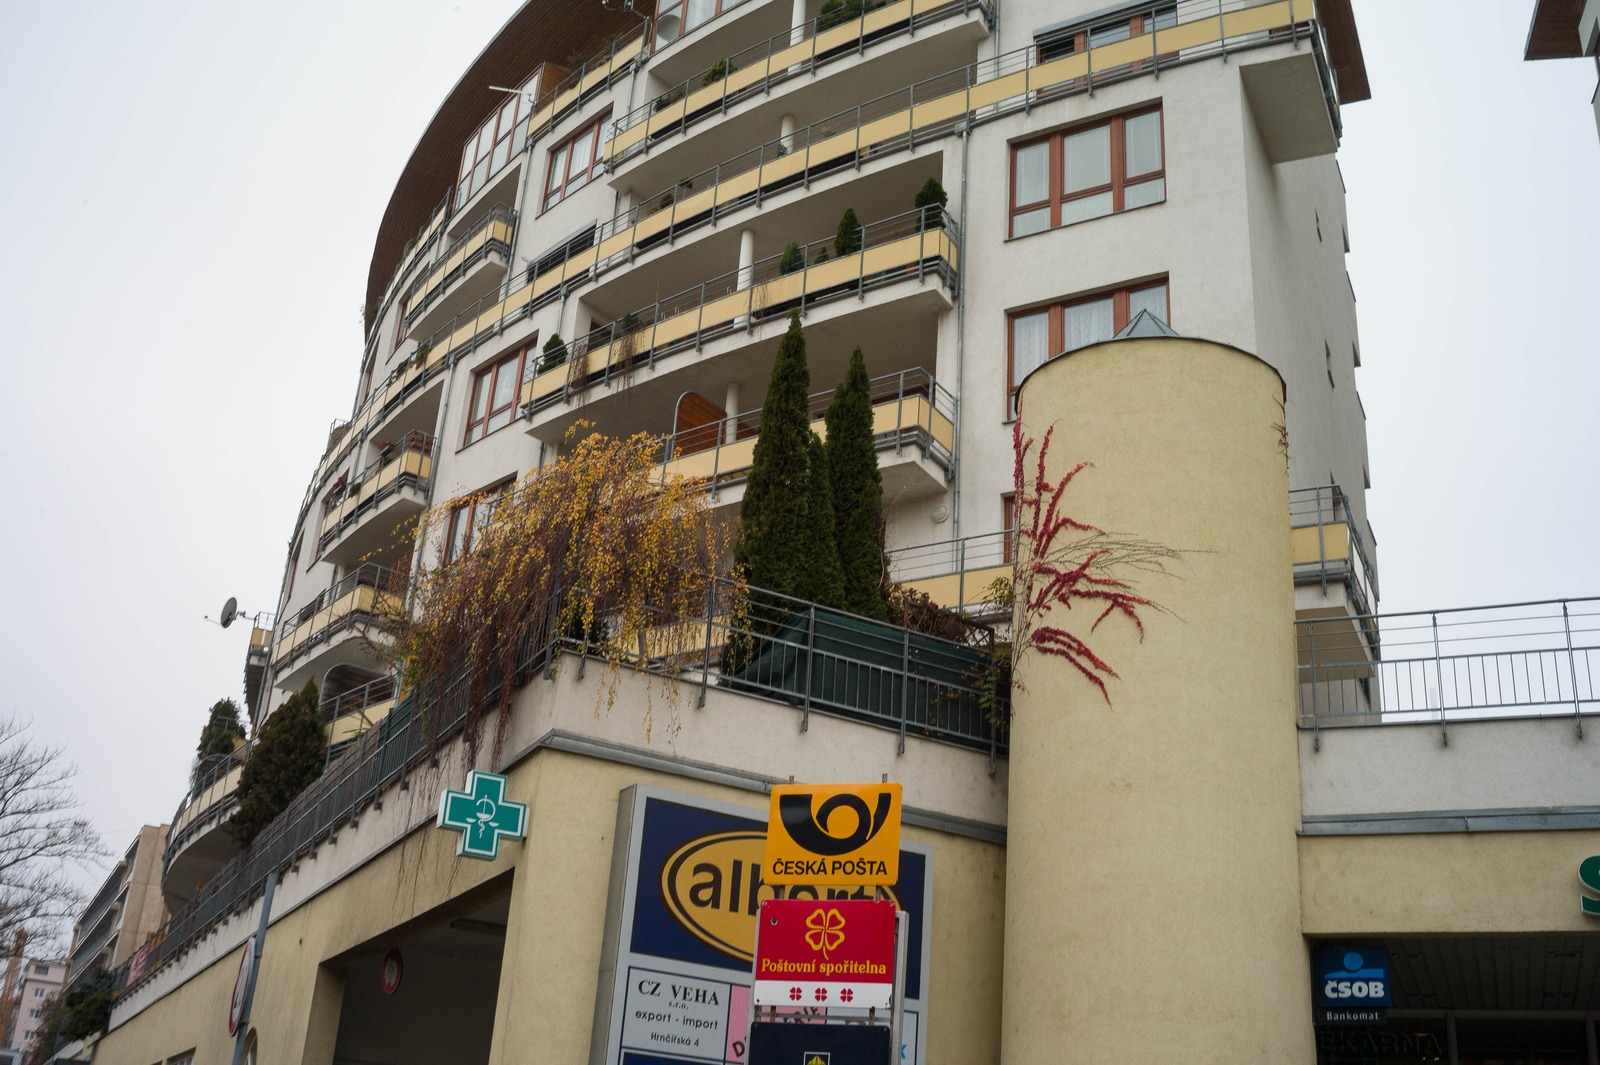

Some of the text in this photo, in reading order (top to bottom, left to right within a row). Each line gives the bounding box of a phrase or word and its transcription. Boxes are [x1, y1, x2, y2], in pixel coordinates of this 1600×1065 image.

[772, 858, 888, 875] ČESKÁ POŠTA
[761, 958, 887, 976] Poštovní spořitelna
[638, 980, 719, 1006] CZ VEHA
[1324, 979, 1385, 998] ČSOB
[668, 1001, 689, 1010] s.r.o.
[635, 1010, 671, 1022] export
[682, 1016, 718, 1030] import
[1326, 1011, 1379, 1020] Bankomat
[650, 1032, 700, 1047] Hrnčířská 4
